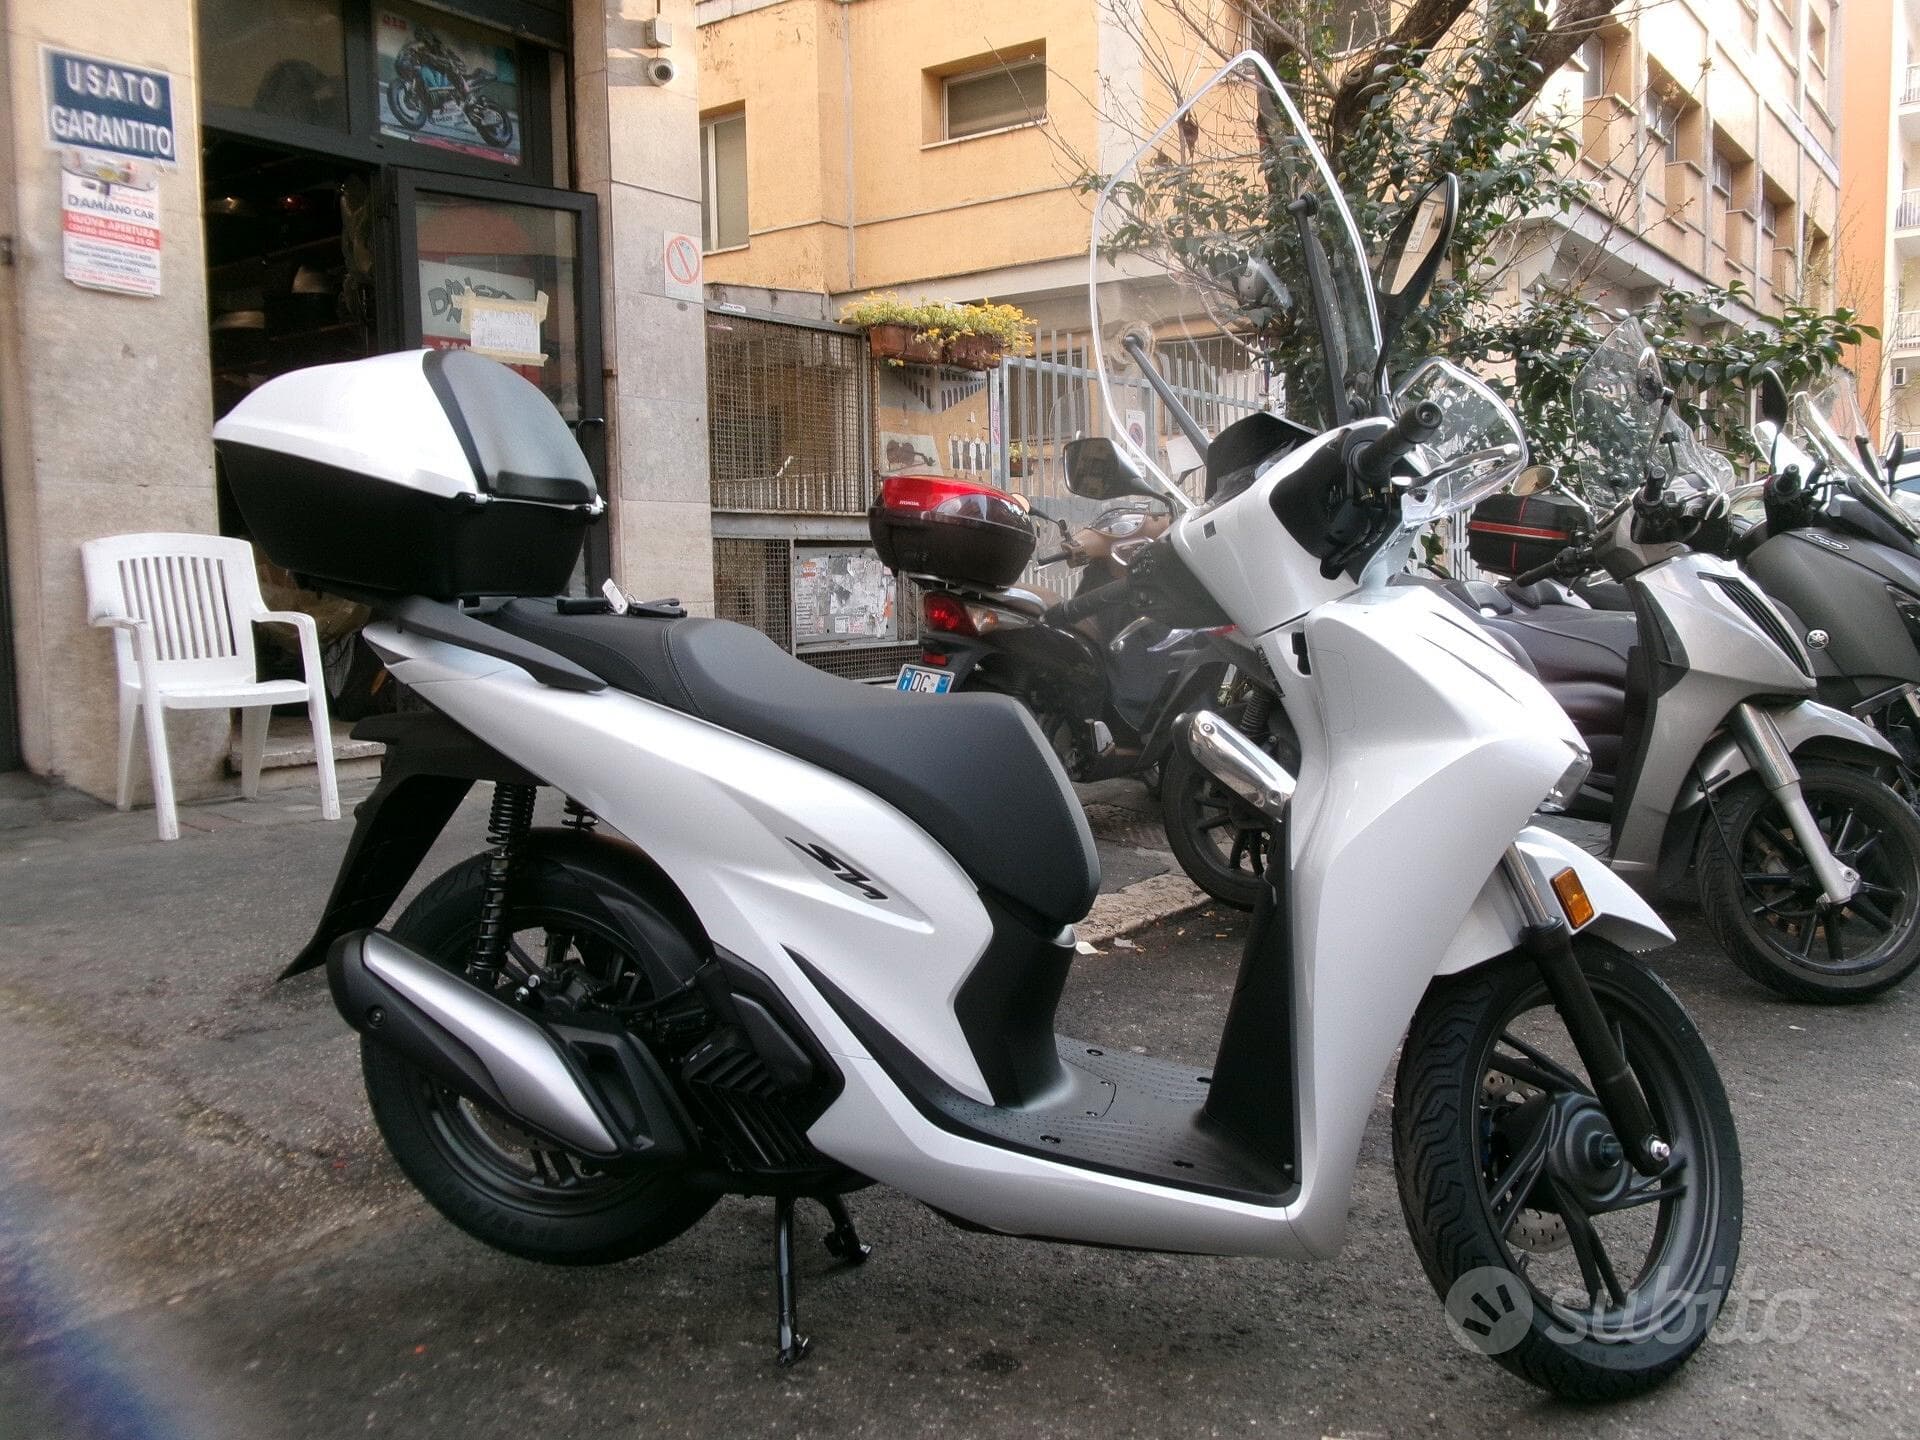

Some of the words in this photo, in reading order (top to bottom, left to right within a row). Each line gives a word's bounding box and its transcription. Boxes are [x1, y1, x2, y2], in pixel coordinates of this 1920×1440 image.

[65, 59, 157, 107] USATO
[51, 104, 171, 155] GARANTITO
[68, 194, 131, 214] DAMIANO
[134, 207, 154, 220] CAR
